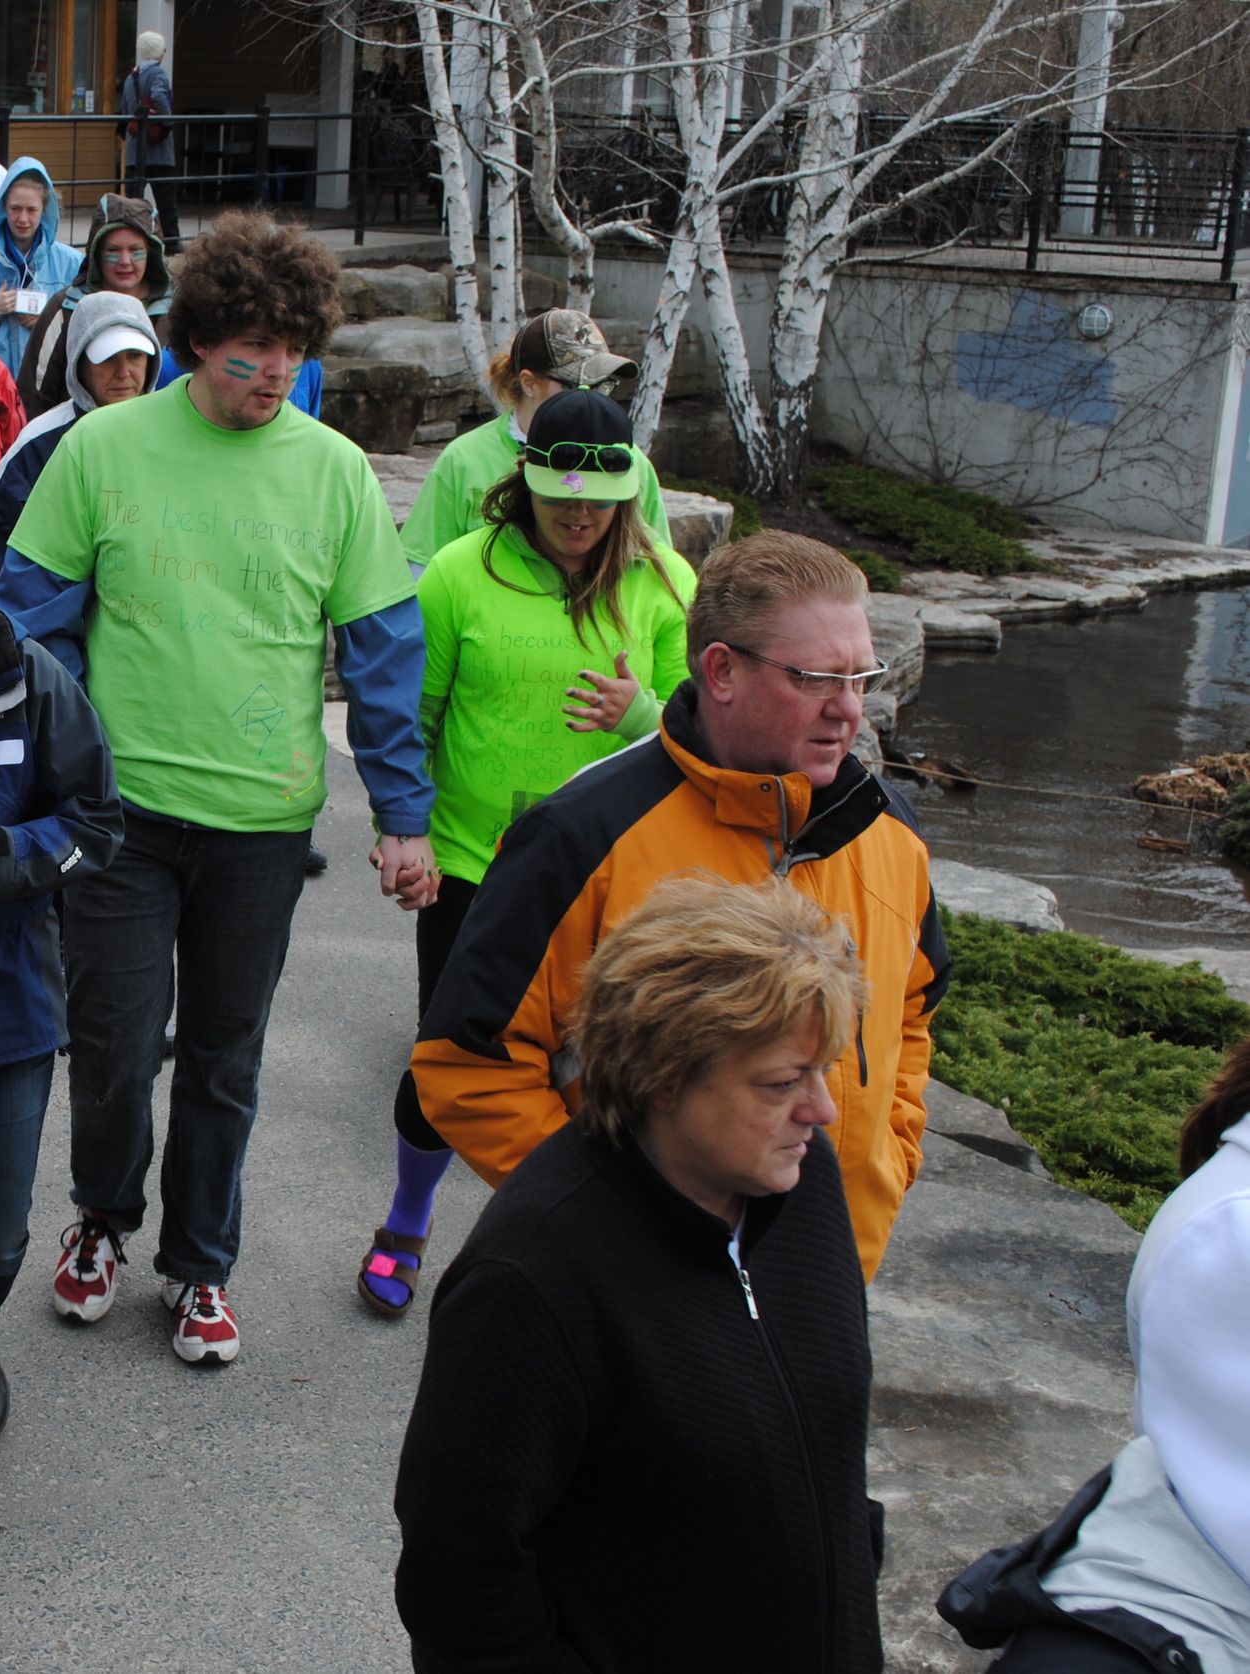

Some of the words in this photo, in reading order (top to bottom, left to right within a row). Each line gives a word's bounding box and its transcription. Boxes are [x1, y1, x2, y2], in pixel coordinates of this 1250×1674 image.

[100, 490, 140, 524] The
[161, 495, 222, 535] best
[234, 518, 344, 559] memories
[147, 538, 219, 587] from
[239, 553, 288, 594] the
[179, 607, 216, 635] we
[231, 600, 305, 645] share
